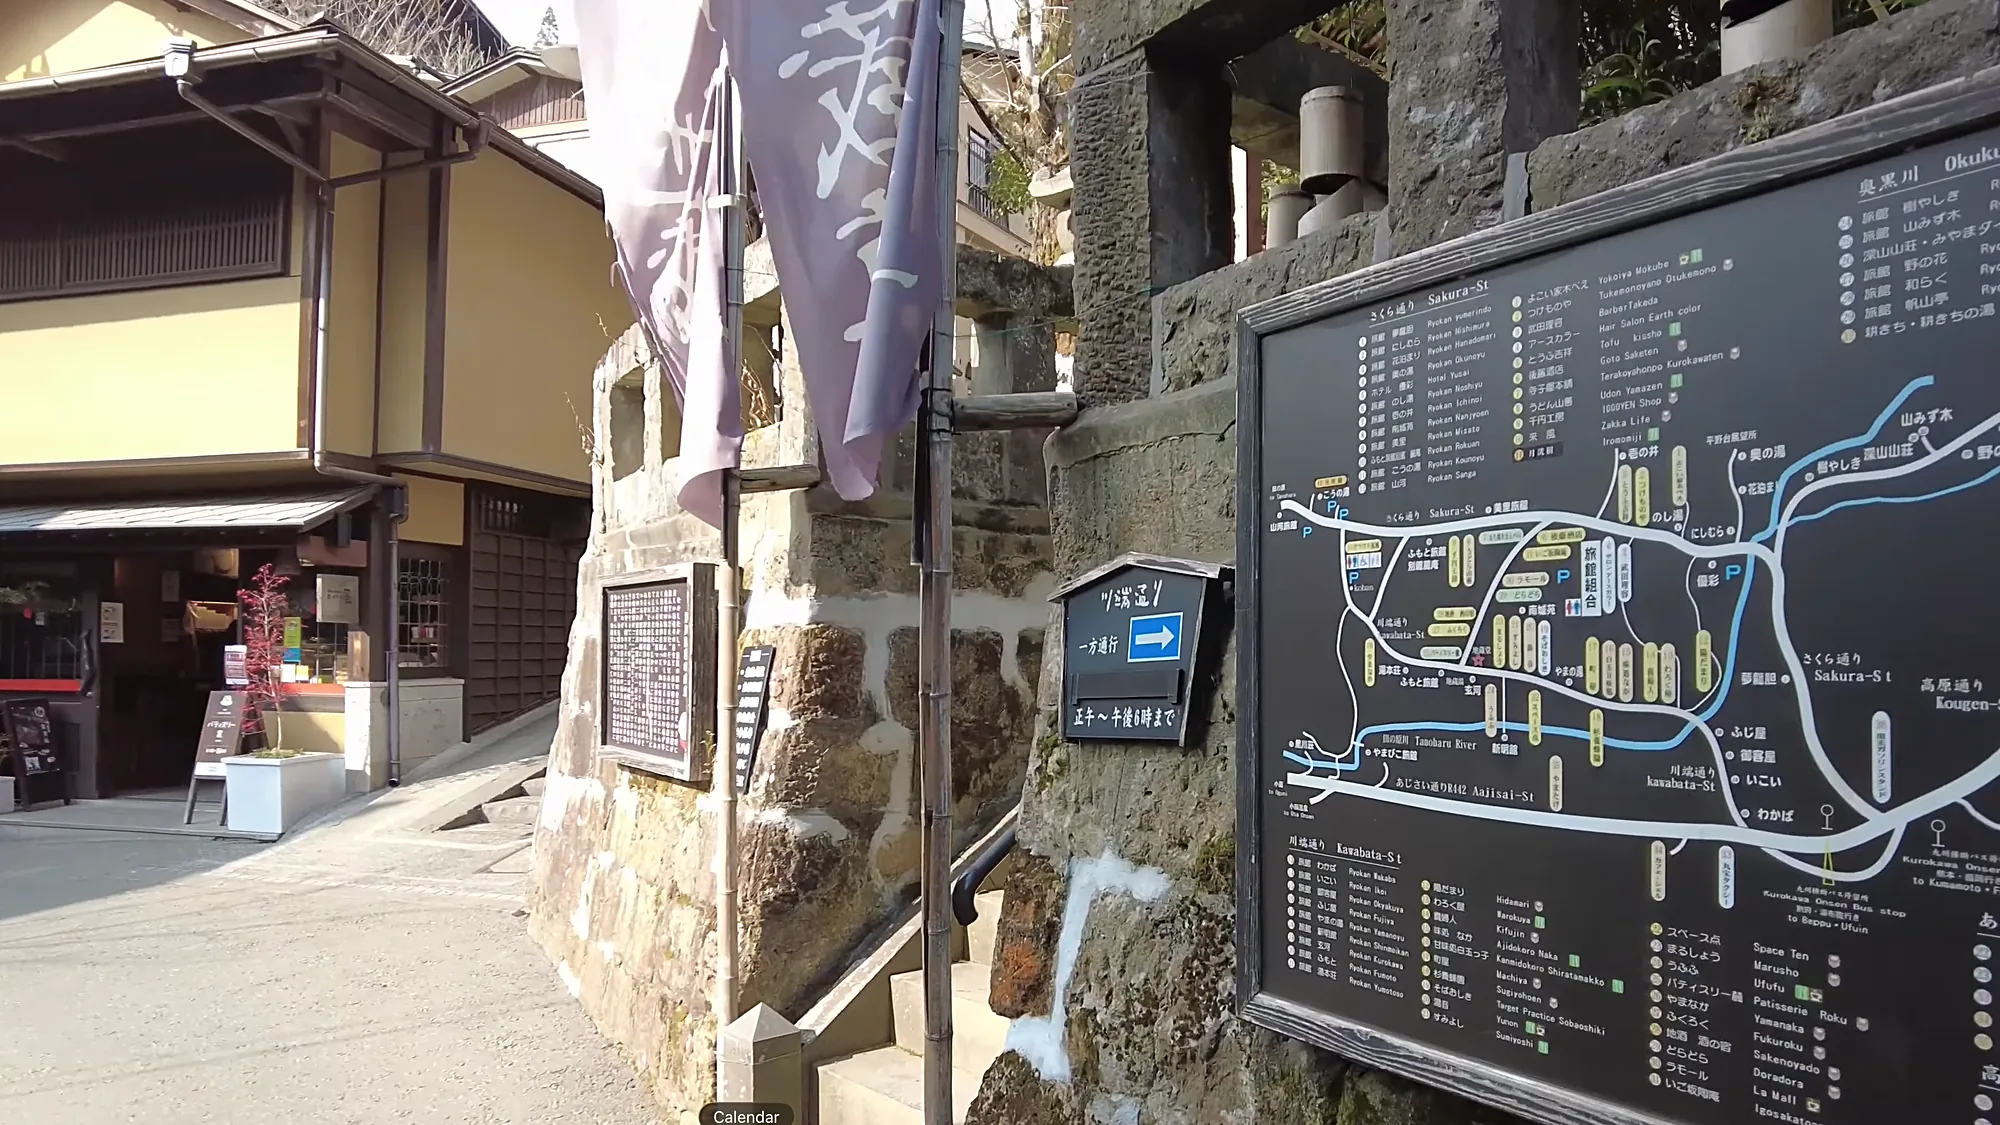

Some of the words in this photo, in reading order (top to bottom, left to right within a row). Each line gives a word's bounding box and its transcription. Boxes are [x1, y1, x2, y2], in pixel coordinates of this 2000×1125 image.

[1858, 166, 1918, 196] 奥黒川
[1636, 260, 1669, 277] Mokube
[1428, 280, 1489, 305] Sakura-St
[1370, 300, 1415, 322] さくら通り
[1427, 317, 1452, 327] Ryokan
[1600, 323, 1615, 333] Hair
[1621, 316, 1645, 328] Salon
[1649, 309, 1673, 322] Earth
[1678, 303, 1701, 315] color
[1427, 331, 1452, 342] Ryokan
[1427, 345, 1452, 356] Ryokan
[1601, 338, 1620, 350] Tofu
[1601, 354, 1620, 365] Goto
[1624, 347, 1658, 361] Saketen
[1427, 359, 1452, 370] Ryokan
[1427, 375, 1446, 384] Hotel
[1450, 369, 1469, 379] Yusai
[1427, 388, 1452, 399] Ryokan
[1601, 389, 1621, 399] Udon
[1626, 381, 1663, 395] Yamazen
[1427, 402, 1452, 412] Ryokan
[1640, 396, 1661, 407] Shop
[1427, 417, 1452, 427] Ryokan
[1601, 418, 1626, 430] Zakka
[1631, 414, 1650, 425] Life
[1901, 407, 1953, 426] 山みず木
[1427, 431, 1452, 441] Ryokan
[1427, 445, 1452, 455] Ryokan
[1427, 459, 1452, 469] Ryokan
[1427, 474, 1452, 482] Ryokan
[1455, 470, 1476, 479] Sanga
[1429, 505, 1474, 518] Sakura-St
[1691, 525, 1724, 538] にしむら
[1584, 547, 1597, 609] 旅館組合
[1079, 635, 1119, 655] 一方通行
[1803, 653, 1860, 666] さくら通り
[1921, 678, 1982, 692] 高原通り
[1455, 739, 1476, 750] River
[1670, 766, 1715, 778] 川端通り
[1746, 776, 1781, 787] いこい
[1758, 809, 1794, 821] わかば
[1289, 836, 1324, 850] 川端通り
[1349, 868, 1371, 878] Ryokan
[1349, 882, 1371, 892] Ryokan
[1913, 877, 1924, 885] to
[1349, 895, 1371, 905] Ryokan
[1349, 909, 1371, 919] Ryokan
[1853, 903, 1873, 912] Bus
[1880, 908, 1906, 917] stop
[1349, 922, 1371, 933] Ryokan
[1497, 925, 1524, 938] Kifujin
[1349, 936, 1371, 946] Ryokan
[1349, 949, 1371, 960] Ryokan
[1538, 950, 1558, 961] Naka
[1667, 943, 1721, 962] まるしょう
[1753, 942, 1784, 957] Space
[1791, 949, 1809, 961] Ten
[1349, 963, 1371, 974] Ryokan
[1668, 961, 1699, 975] うふふ
[1754, 961, 1799, 978] Marusho
[1350, 977, 1371, 989] Ryokan
[1754, 979, 1785, 993] Ufufu
[1523, 1007, 1556, 1023] Practice
[1754, 996, 1808, 1016] Patisserie
[1820, 1010, 1848, 1025] Roku
[1497, 1016, 1518, 1028] Yunon
[1667, 1011, 1709, 1030] ふくろく
[1754, 1014, 1804, 1033] Yamanaka
[1754, 1032, 1803, 1052] Fukuroku
[1667, 1044, 1708, 1064] どらどら
[1754, 1050, 1820, 1075] Sakenoyado
[1667, 1062, 1708, 1081] ラモール
[1754, 1068, 1804, 1089] Doradora
[1753, 1086, 1768, 1098] La
[1772, 1087, 1797, 1105] Mall
